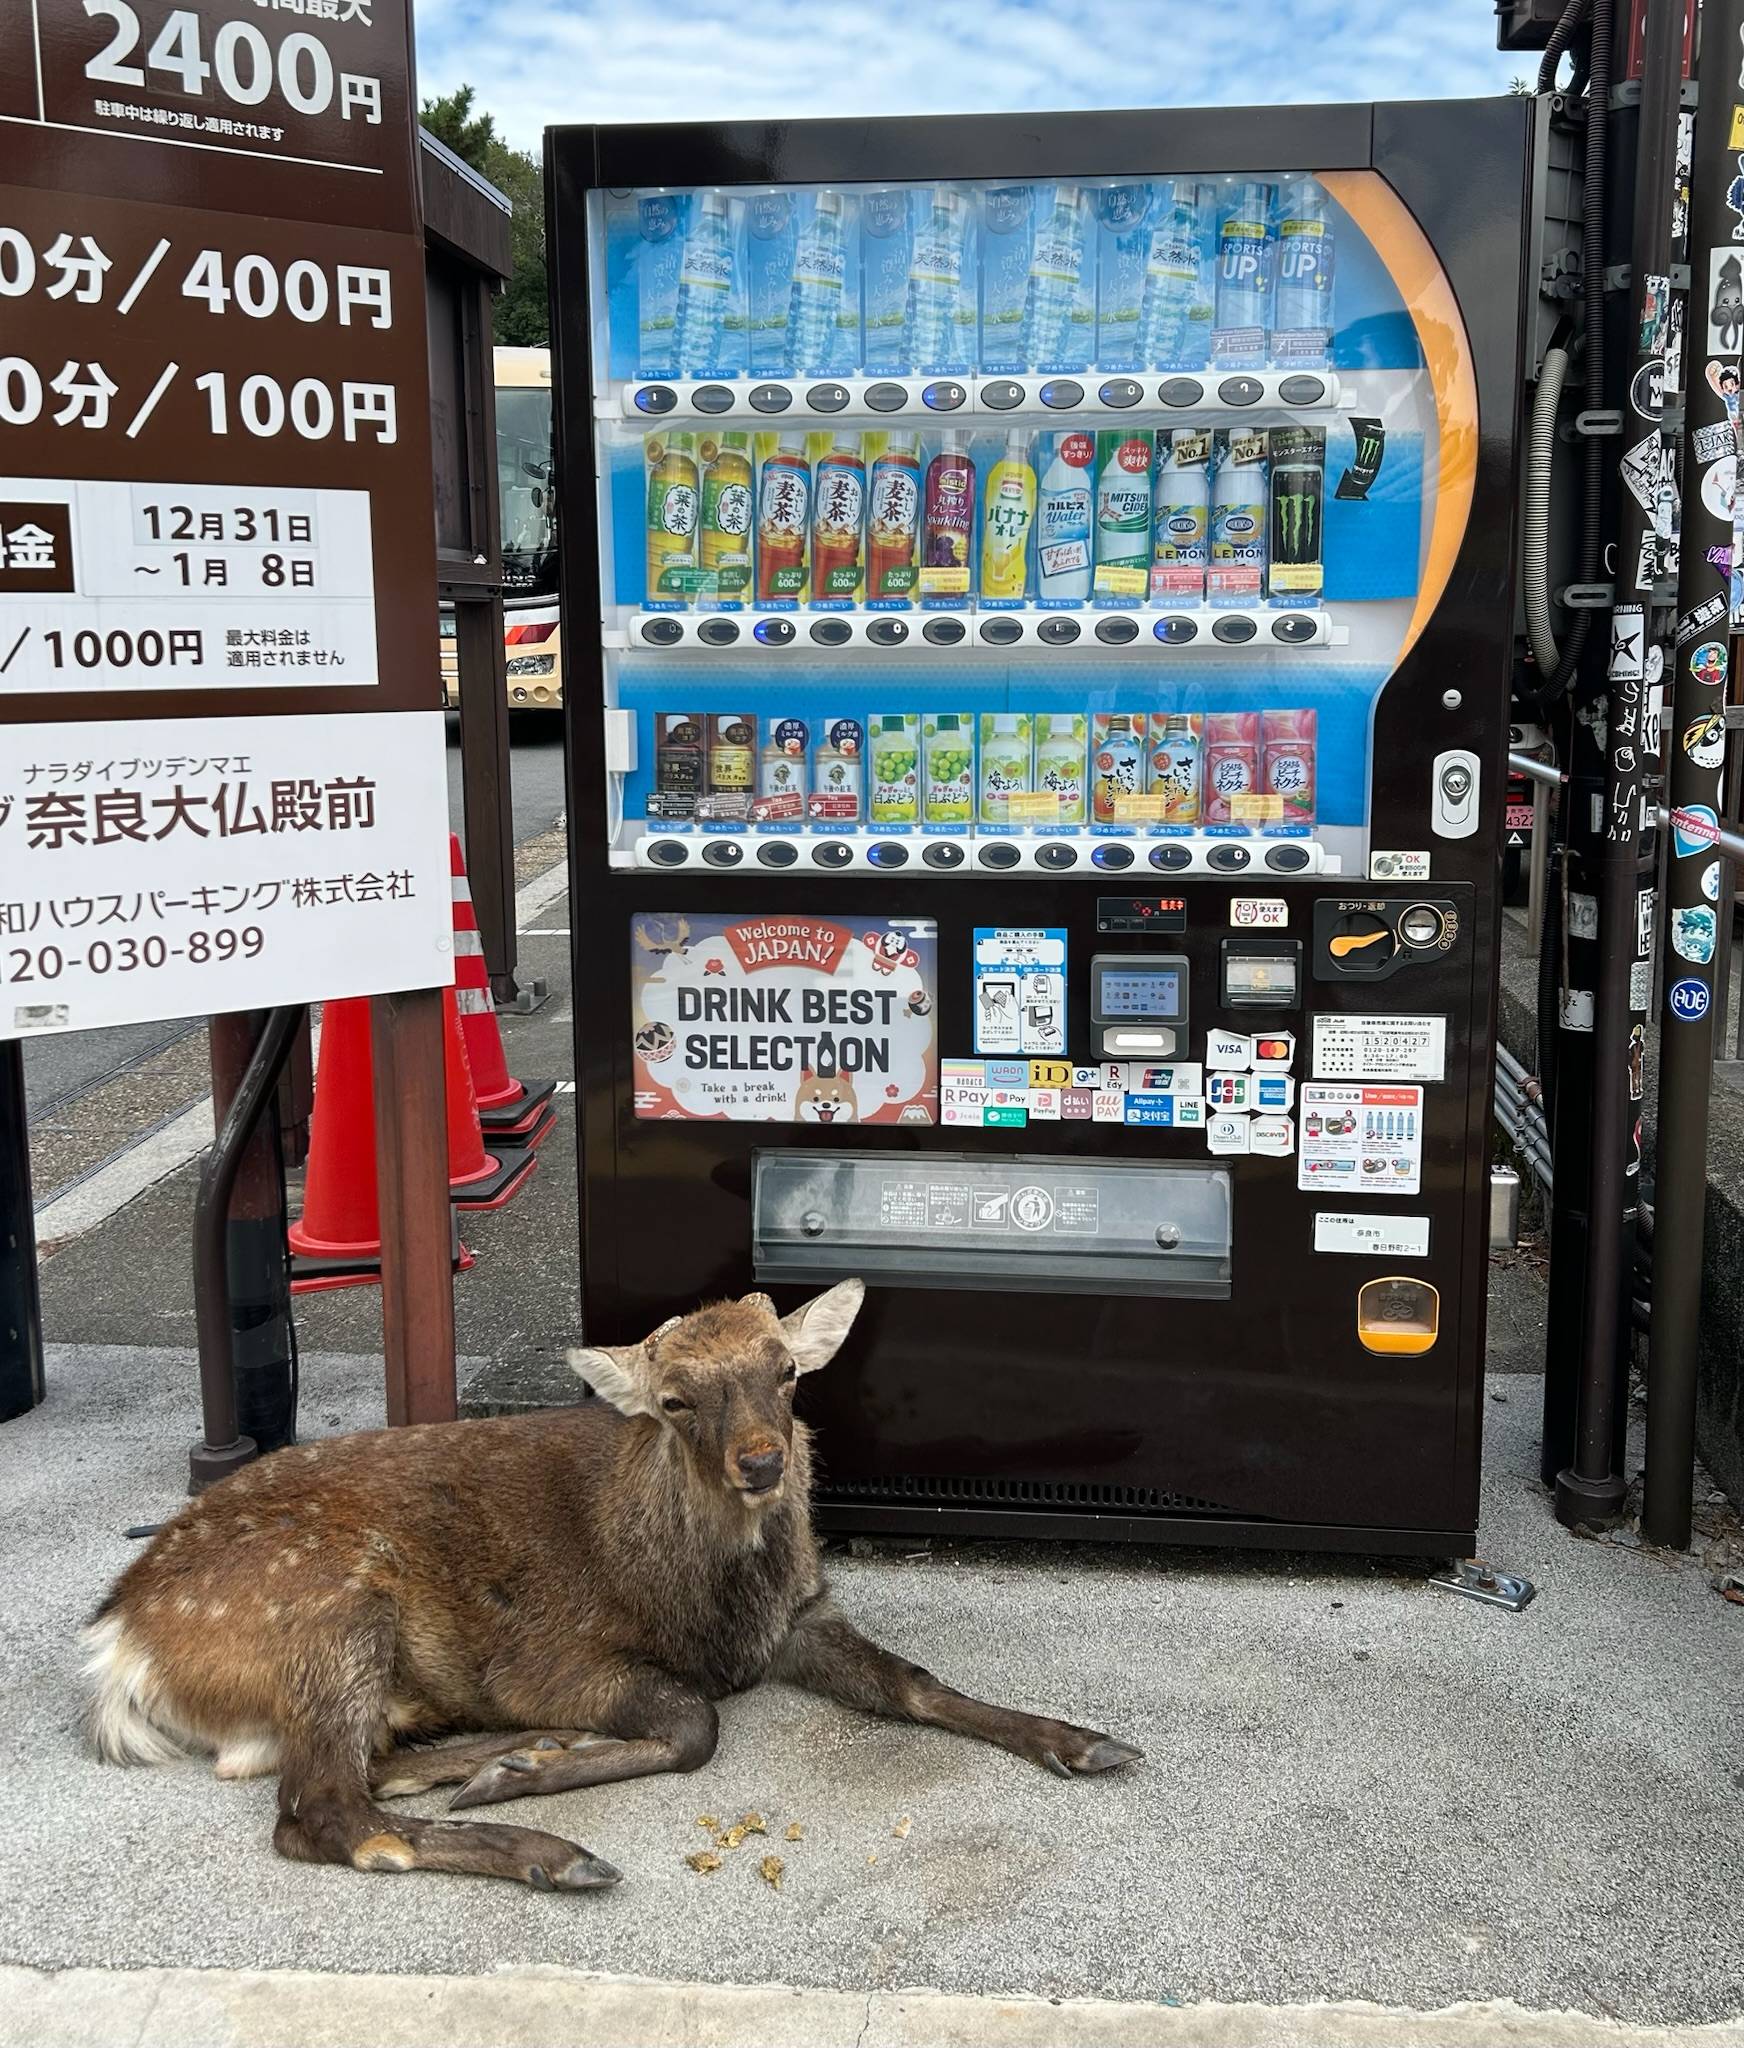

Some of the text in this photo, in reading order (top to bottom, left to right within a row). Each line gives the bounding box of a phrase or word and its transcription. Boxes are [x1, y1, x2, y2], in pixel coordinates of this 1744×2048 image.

[95, 99, 285, 142] 駐車中は繰り返し適用されます
[1153, 247, 1199, 266] 天然水
[1223, 243, 1263, 256] SPORTS
[1282, 242, 1322, 255] SPORTS
[684, 257, 730, 276] 天然水
[798, 255, 844, 277] 天然水
[914, 253, 961, 272] 天然水
[1034, 249, 1079, 269] 天然水
[1222, 255, 1258, 280] UP
[1281, 254, 1317, 279] UP
[673, 489, 692, 531] 葉の茶
[727, 489, 746, 531] 葉の茶
[772, 480, 796, 523] 麦茶
[826, 479, 851, 522] 麦茶
[881, 479, 906, 522] 麦茶
[1047, 501, 1085, 511] カルピス
[142, 505, 313, 543] 12月31日
[988, 505, 1029, 526] バナナ
[1044, 510, 1086, 524] Water
[0, 523, 57, 570] 金
[1157, 549, 1206, 560] LEMON
[1214, 549, 1263, 559] LEMON
[226, 628, 311, 648] 最大料金は
[226, 649, 345, 668] 適用されません
[23, 755, 253, 786] ナラダイブツデンマエ
[1215, 779, 1249, 790] ネクター
[1273, 778, 1306, 790] ネクター
[874, 793, 915, 805] 白ぶどう
[928, 793, 969, 805] 白ぶどう
[1405, 855, 1421, 863] OK
[1263, 913, 1280, 922] OK
[736, 922, 835, 944] Welcome to
[0, 925, 265, 985] 20-030-899
[744, 938, 836, 966] JAPAN!
[677, 986, 898, 1025] DRINK BEST
[1216, 1044, 1243, 1054] VISA
[1034, 1064, 1069, 1084] iD
[701, 1081, 775, 1093] Take a break
[1106, 1081, 1122, 1090] Edy
[714, 1092, 787, 1105] with a drink!
[959, 1090, 989, 1106] Pay
[1009, 1094, 1026, 1105] Pay
[1179, 1101, 1199, 1109] LINE
[1097, 1106, 1120, 1117] PAY
[1181, 1112, 1197, 1121] Pay
